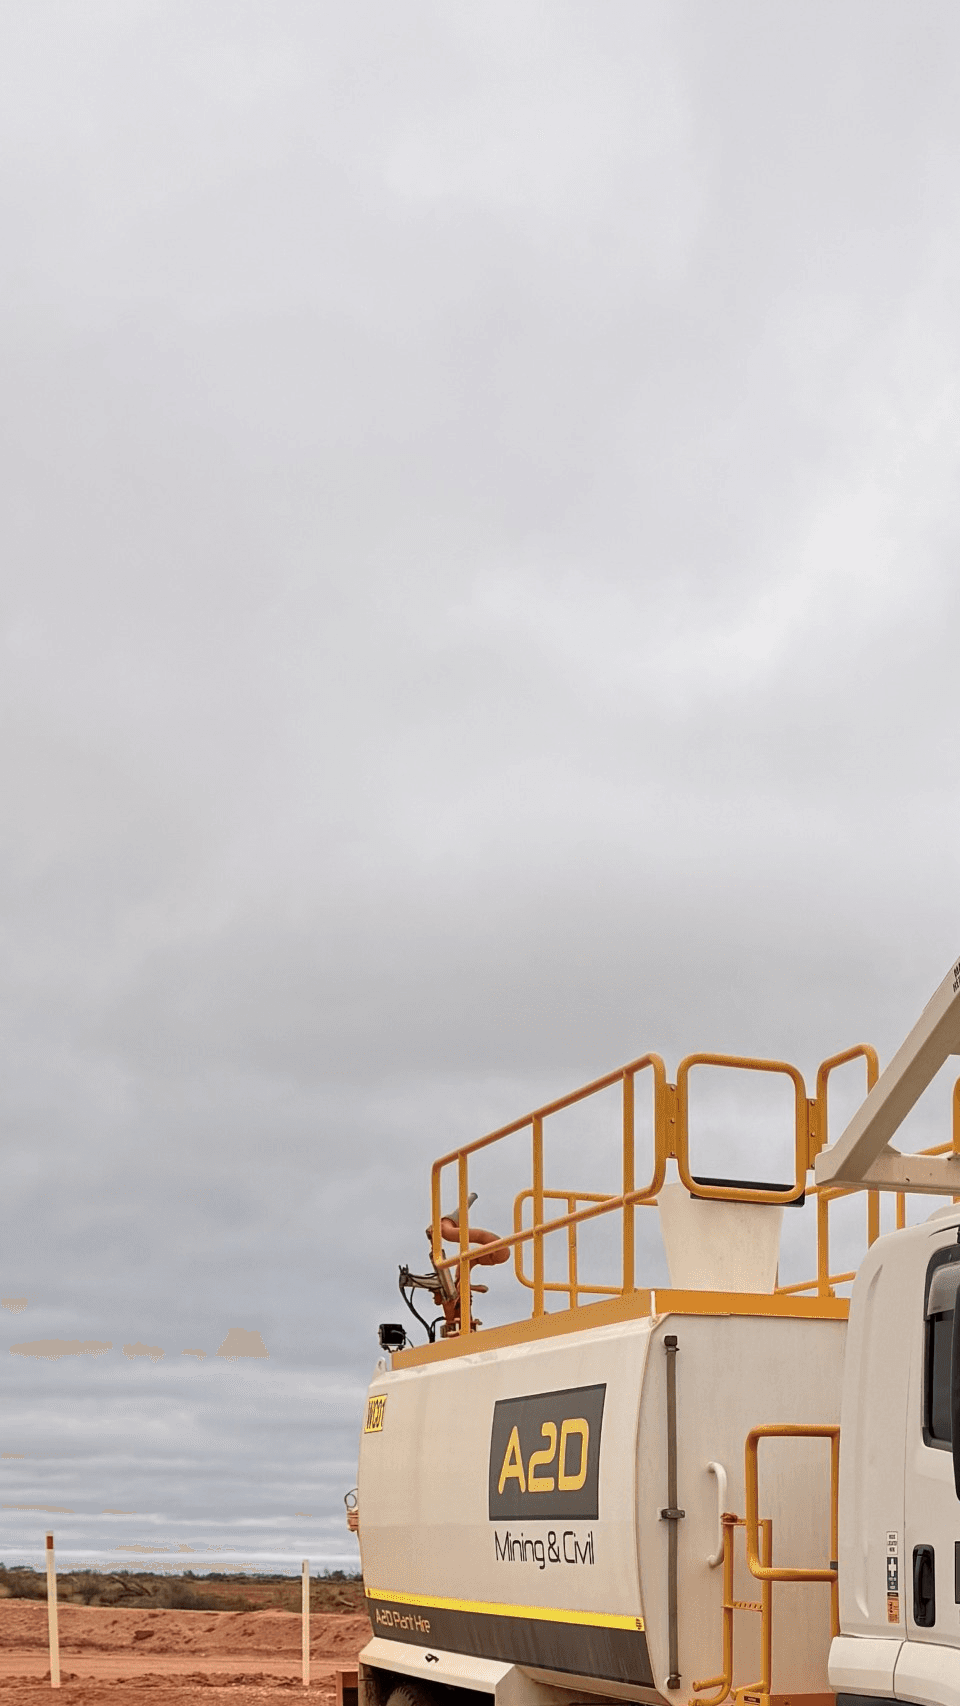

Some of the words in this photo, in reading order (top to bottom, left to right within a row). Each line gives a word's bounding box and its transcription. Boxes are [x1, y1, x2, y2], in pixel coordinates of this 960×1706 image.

[498, 1417, 590, 1495] A2D
[494, 1530, 546, 1570] Mining
[547, 1530, 562, 1564] &
[562, 1530, 595, 1566] Civil
